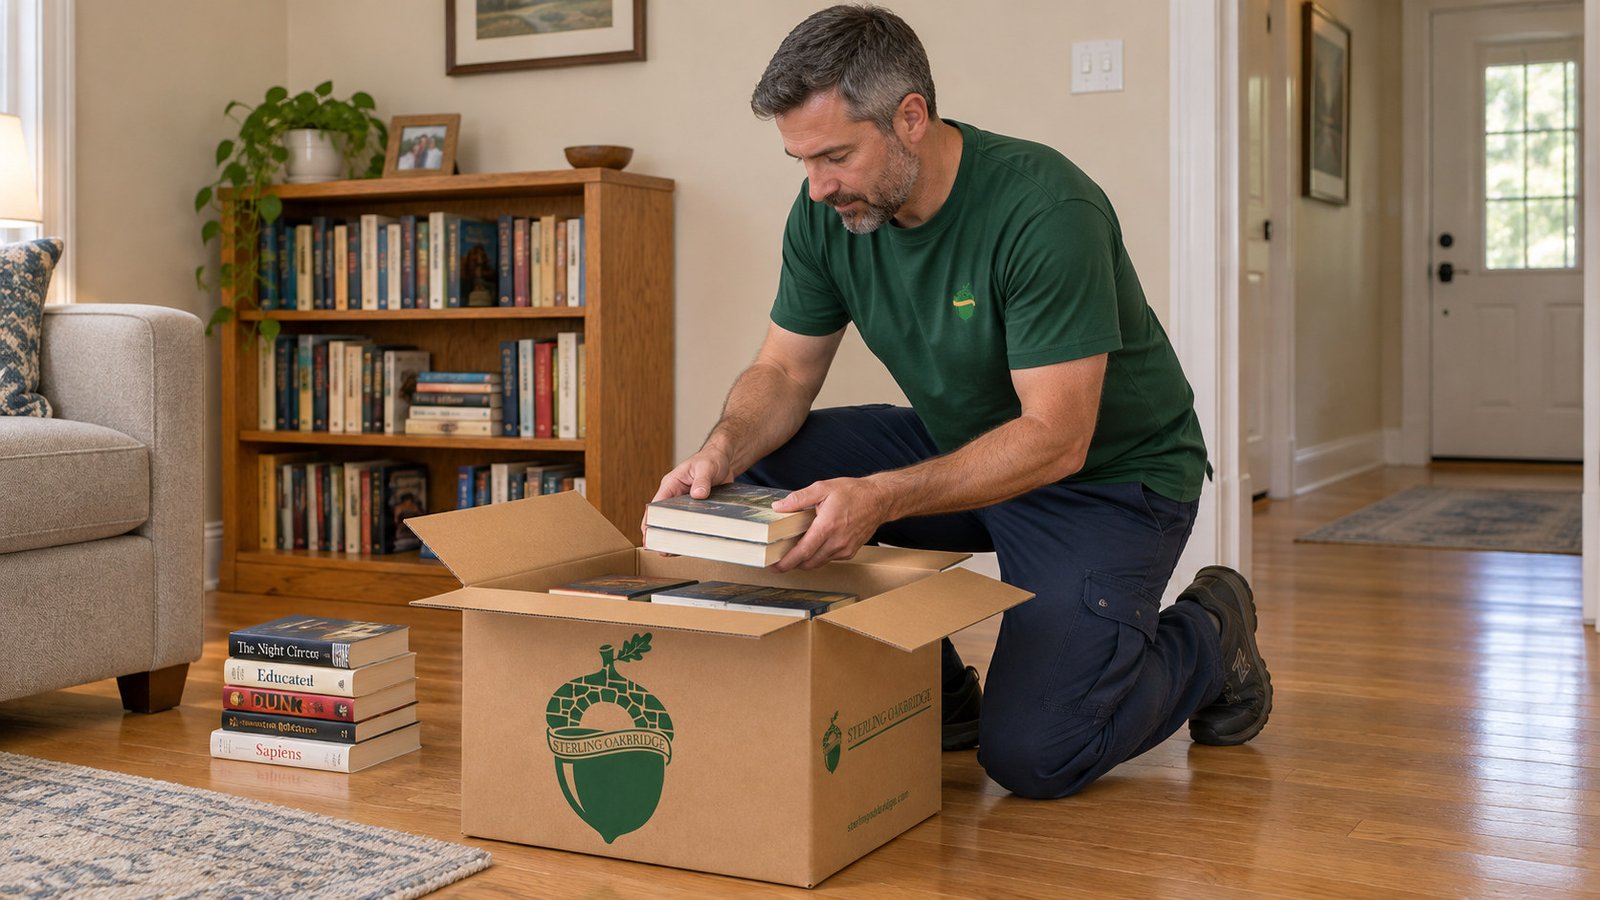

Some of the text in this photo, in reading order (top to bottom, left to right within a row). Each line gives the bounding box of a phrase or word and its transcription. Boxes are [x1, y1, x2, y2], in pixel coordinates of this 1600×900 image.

[237, 640, 255, 655] The
[257, 642, 285, 658] Night
[256, 668, 314, 687] Educated
[847, 687, 932, 743] STERLING OAKBRIDGE
[255, 742, 302, 761] Sapiens
[553, 733, 665, 754] STERLING OAKBRIDGE
